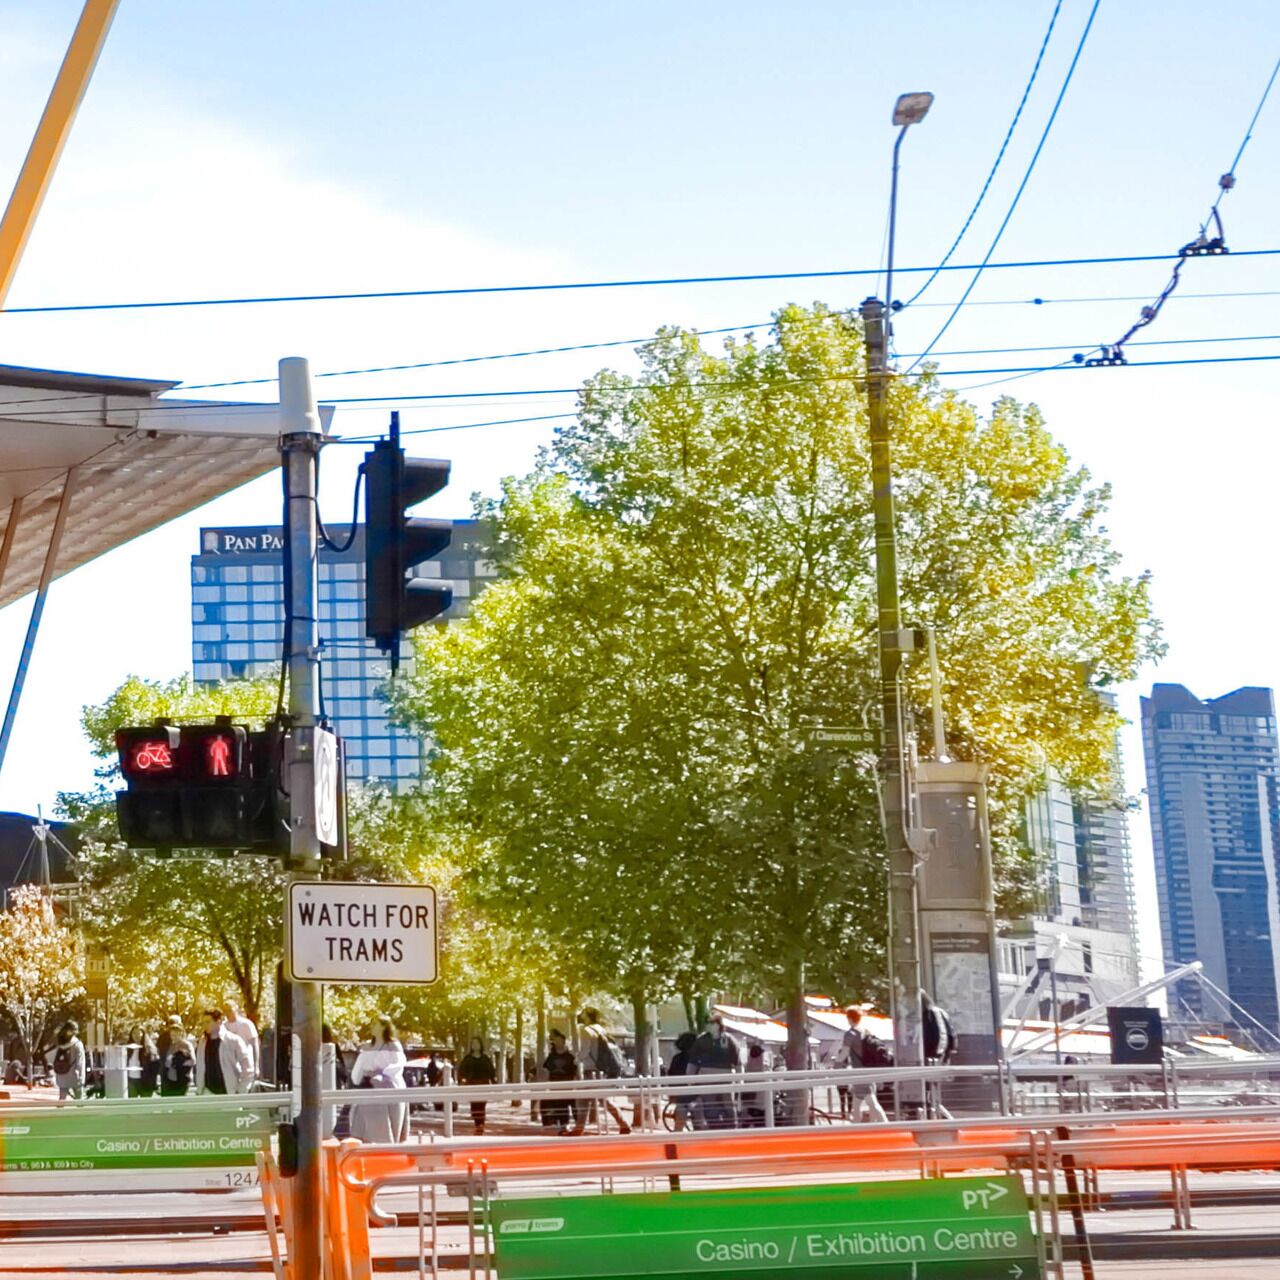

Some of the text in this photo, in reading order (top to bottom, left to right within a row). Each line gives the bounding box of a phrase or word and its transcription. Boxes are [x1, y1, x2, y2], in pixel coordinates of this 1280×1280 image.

[224, 535, 257, 550] PAN
[298, 902, 429, 929] WATCH FOR
[325, 937, 403, 963] TRAMS
[96, 1138, 140, 1153] Casino
[154, 1137, 216, 1151] Exhibition
[219, 1136, 262, 1150] Centre
[695, 1239, 779, 1263] Casino
[806, 1231, 926, 1258] Exhibition
[933, 1228, 1019, 1252] Centre
